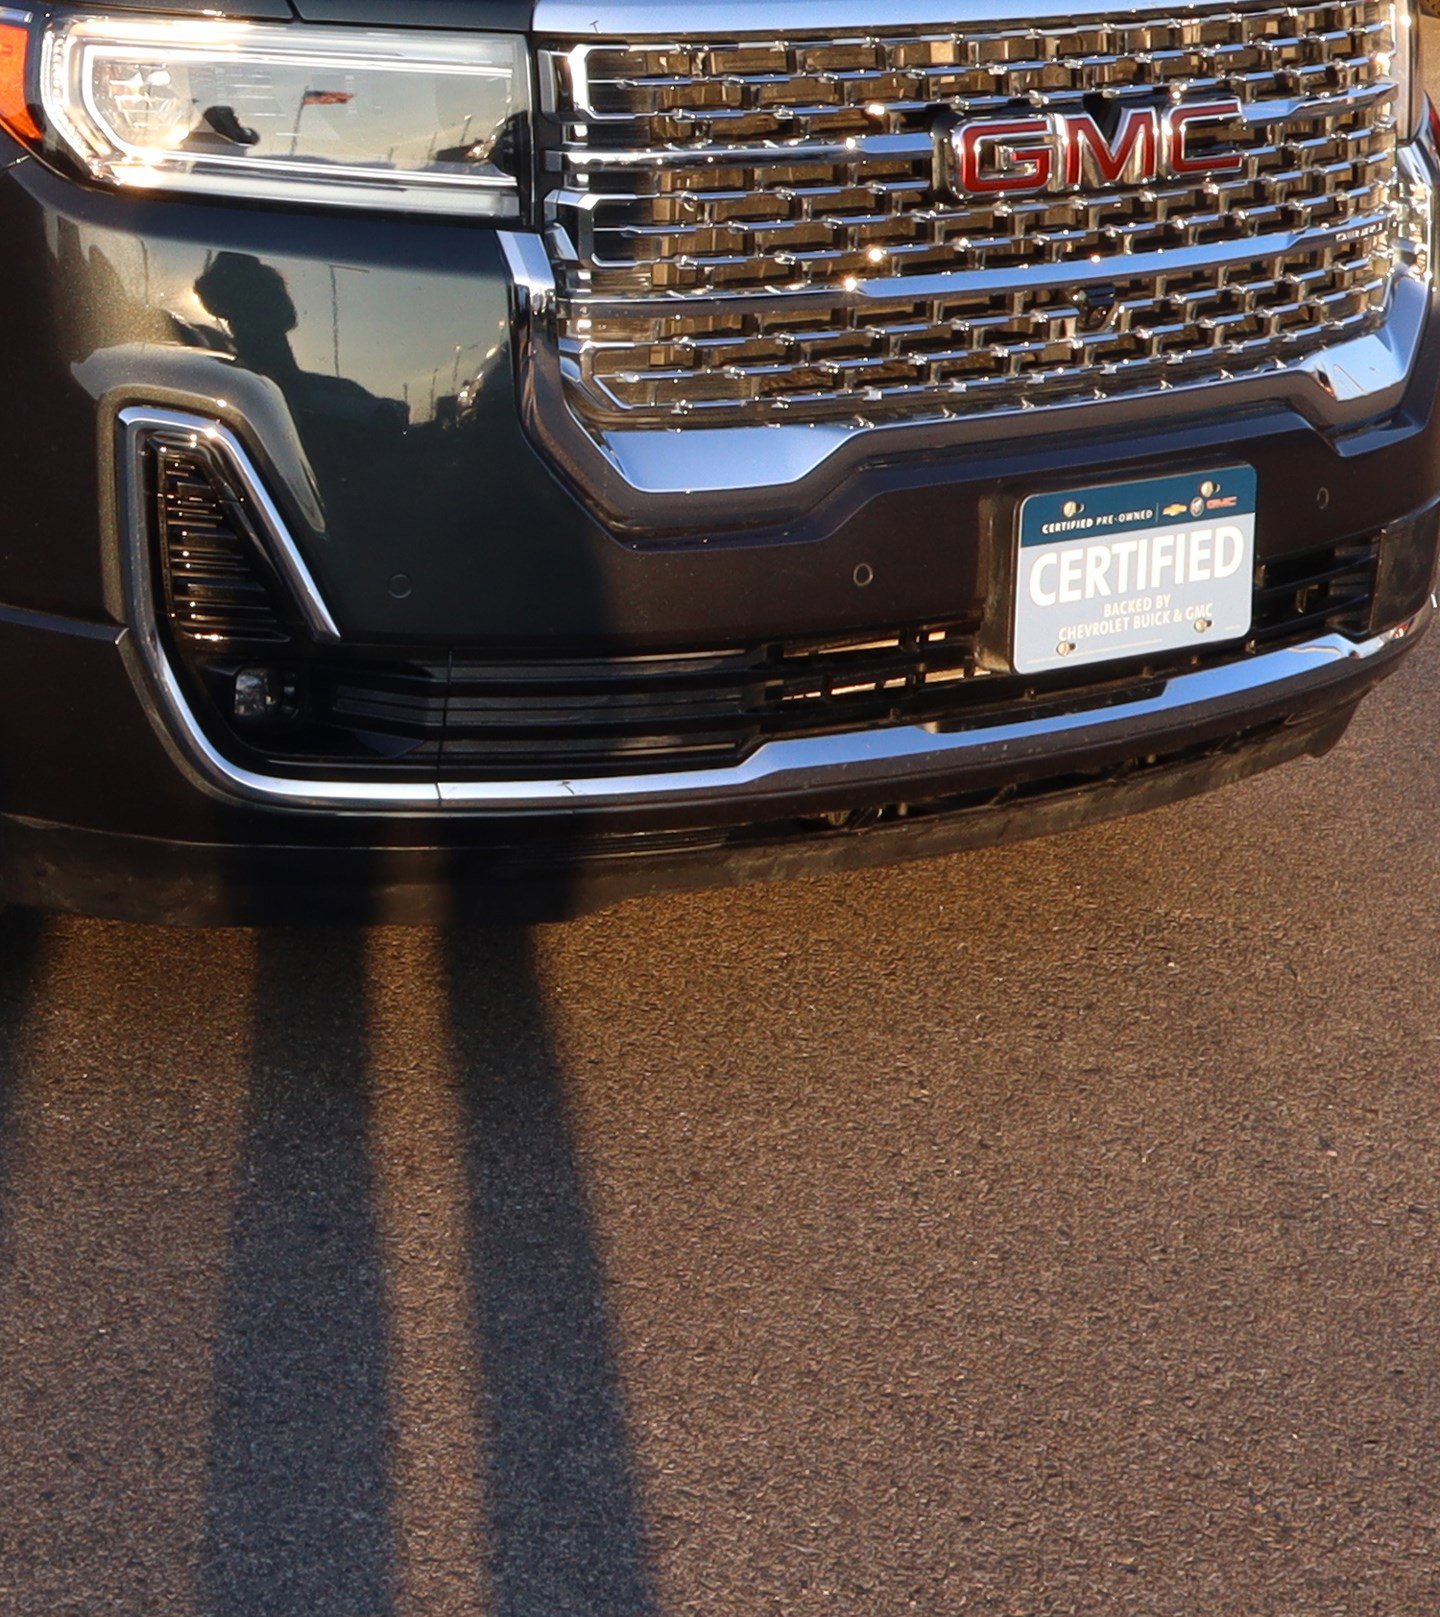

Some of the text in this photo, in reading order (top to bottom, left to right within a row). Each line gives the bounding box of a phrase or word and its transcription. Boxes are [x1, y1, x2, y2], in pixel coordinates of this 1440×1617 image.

[949, 95, 1243, 200] GMC
[1041, 517, 1094, 534] CERTIFIED
[1095, 509, 1154, 527] PRE-OWNED
[1029, 525, 1245, 607] CERTIFIED
[1058, 602, 1213, 641] CHEVROLET BUICK & GMC
[1103, 593, 1171, 618] BACKED BY
